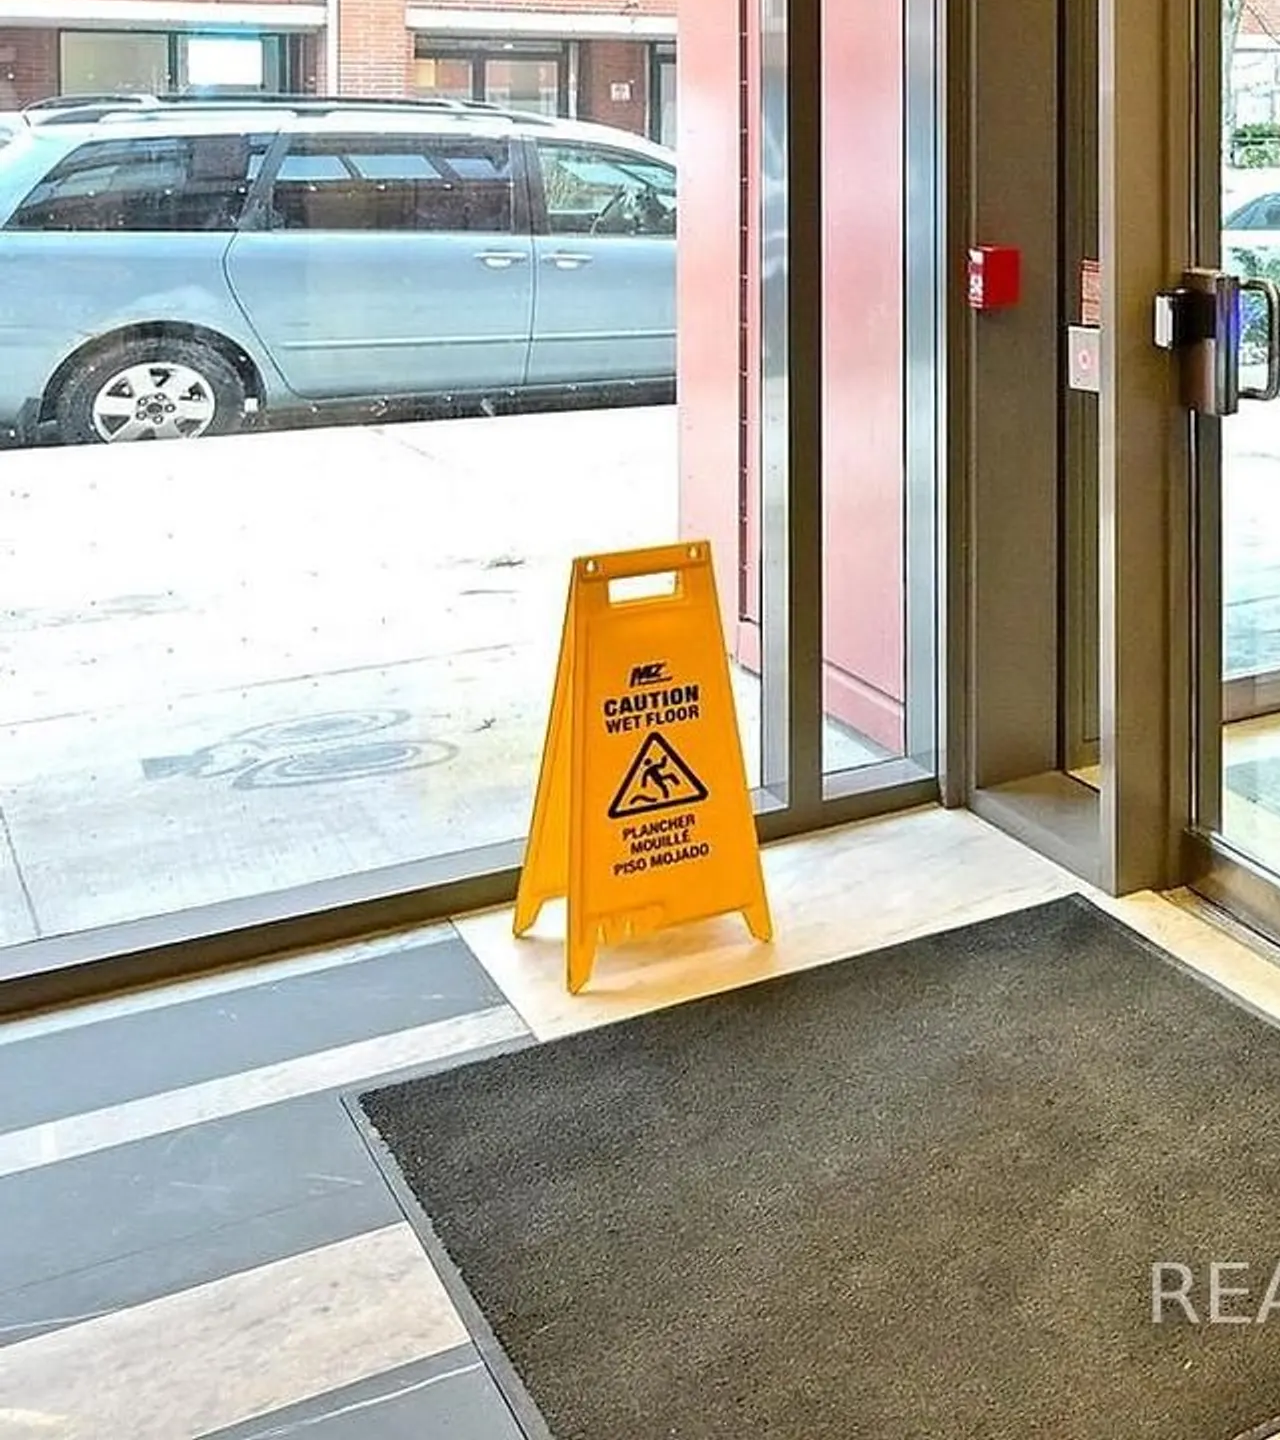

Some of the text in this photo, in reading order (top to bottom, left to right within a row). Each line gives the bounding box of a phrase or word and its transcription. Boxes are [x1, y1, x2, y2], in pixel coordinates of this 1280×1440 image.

[604, 685, 699, 717] CAUTION
[606, 705, 699, 734] WET FLOOR
[622, 814, 695, 841] PLANCHER
[613, 843, 709, 875] PISO MOJADO
